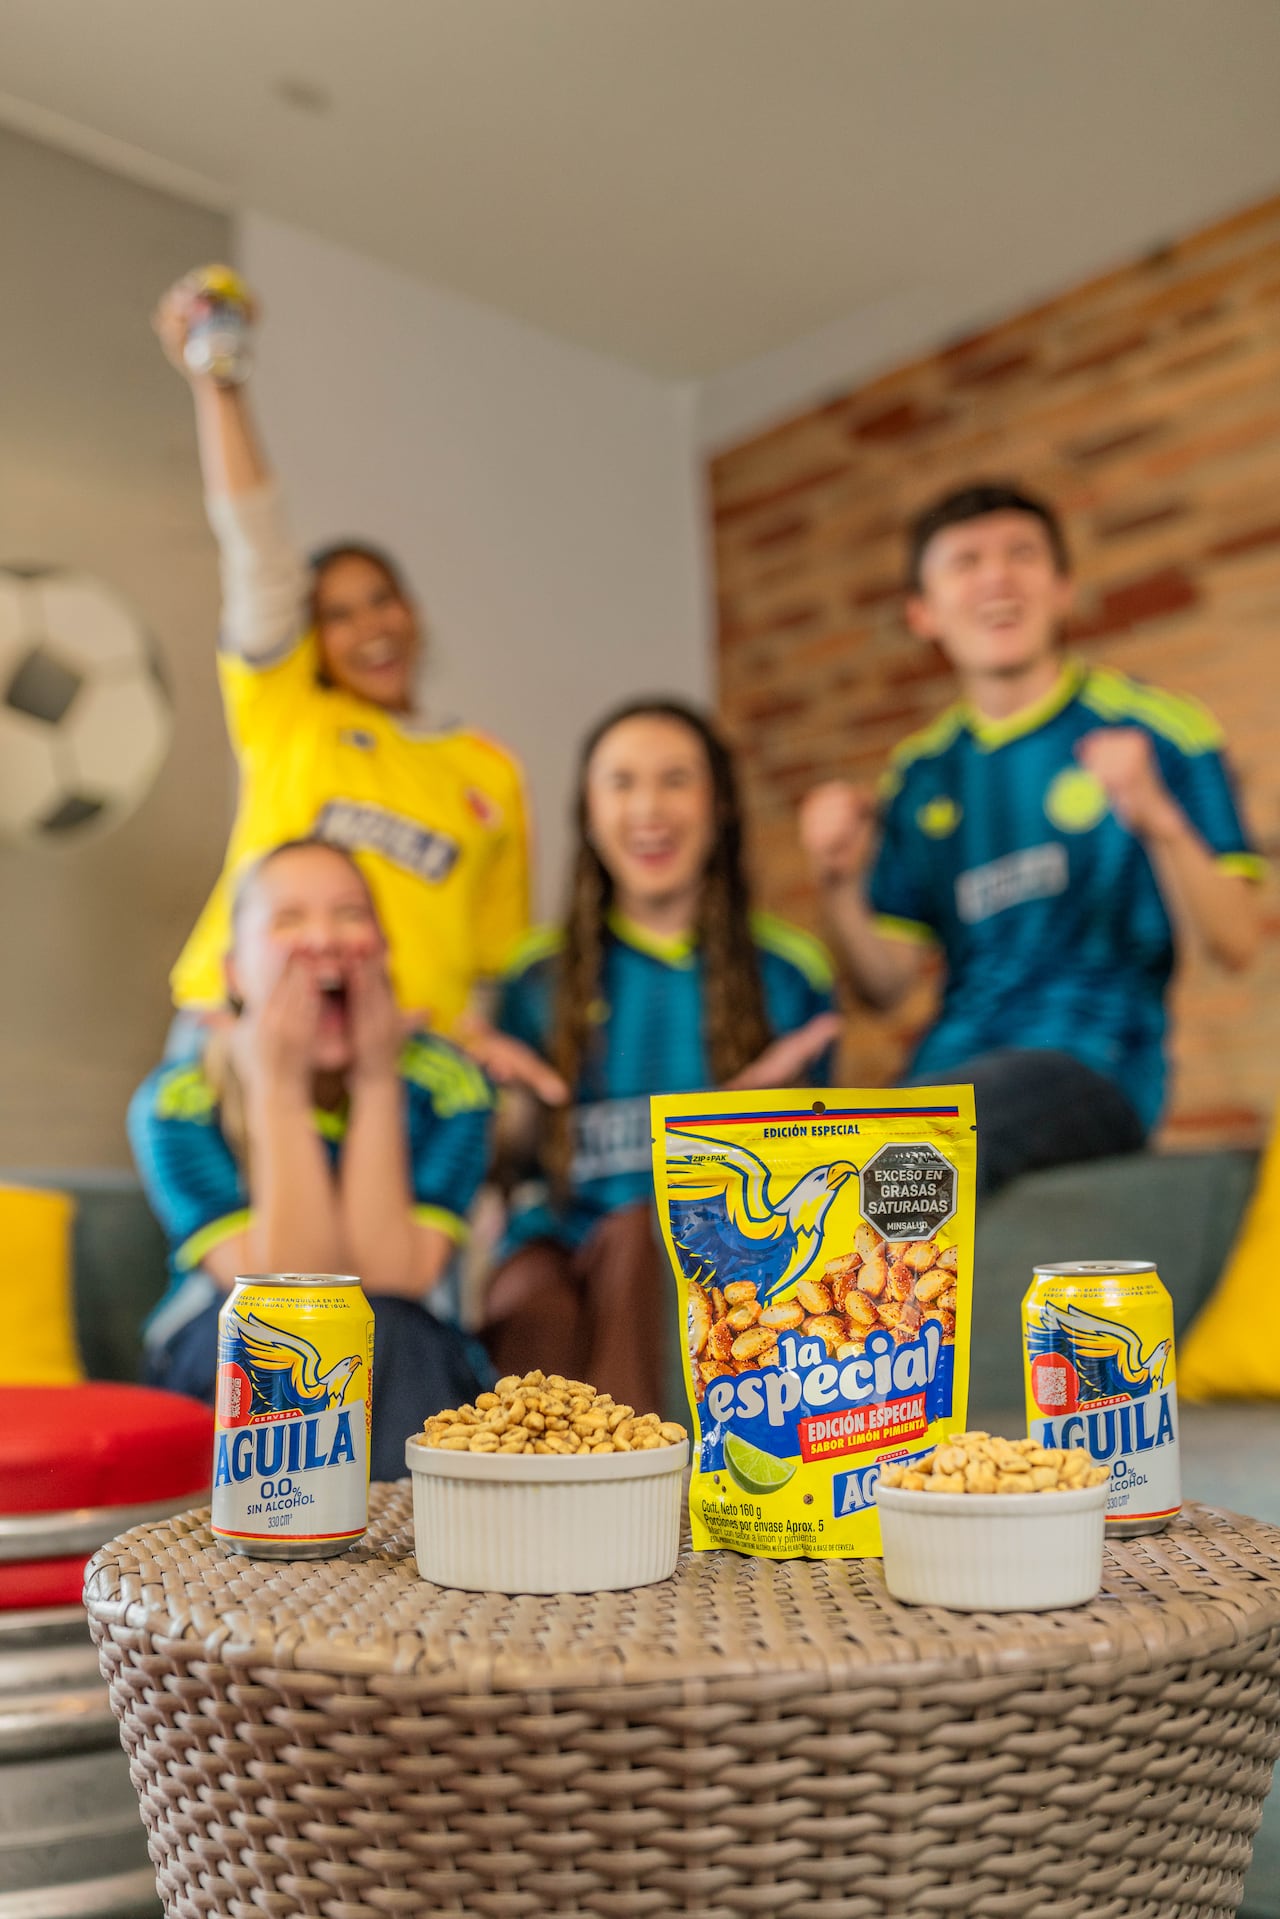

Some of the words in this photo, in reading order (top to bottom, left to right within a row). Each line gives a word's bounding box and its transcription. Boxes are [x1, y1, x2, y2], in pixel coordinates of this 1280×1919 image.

[763, 1124, 807, 1138] EDICIÓN
[811, 1124, 860, 1137] ESPECIAL
[874, 1170, 923, 1182] EXCESO
[925, 1170, 943, 1181] EN
[881, 1183, 937, 1198] GRASAS
[868, 1199, 949, 1216] SATURADAS
[887, 1221, 928, 1232] MINSALUD
[781, 1337, 822, 1370] la
[708, 1326, 940, 1427] especial
[1083, 1396, 1128, 1410] CERVEZA
[254, 1411, 299, 1423] CERVEZA
[808, 1410, 865, 1443] EDICIÓN
[869, 1398, 924, 1430] ESPECIAL
[810, 1438, 845, 1455] SABOR
[847, 1429, 880, 1447] LIMÓN
[883, 1418, 925, 1439] PIMIENTA
[215, 1410, 355, 1488] AGUILA
[1110, 1475, 1148, 1493] LCOHOL
[247, 1503, 262, 1515] SIN
[265, 1494, 315, 1512] ALCOHOL
[721, 1502, 738, 1516] Neto
[740, 1503, 754, 1517] 160
[756, 1506, 762, 1520] g
[704, 1514, 738, 1530] Porciones
[740, 1520, 752, 1533] por
[754, 1522, 784, 1533] envase
[786, 1520, 815, 1535] Aprox.
[818, 1519, 824, 1532] 5
[777, 1536, 783, 1545] y
[785, 1533, 817, 1545] pimienta
